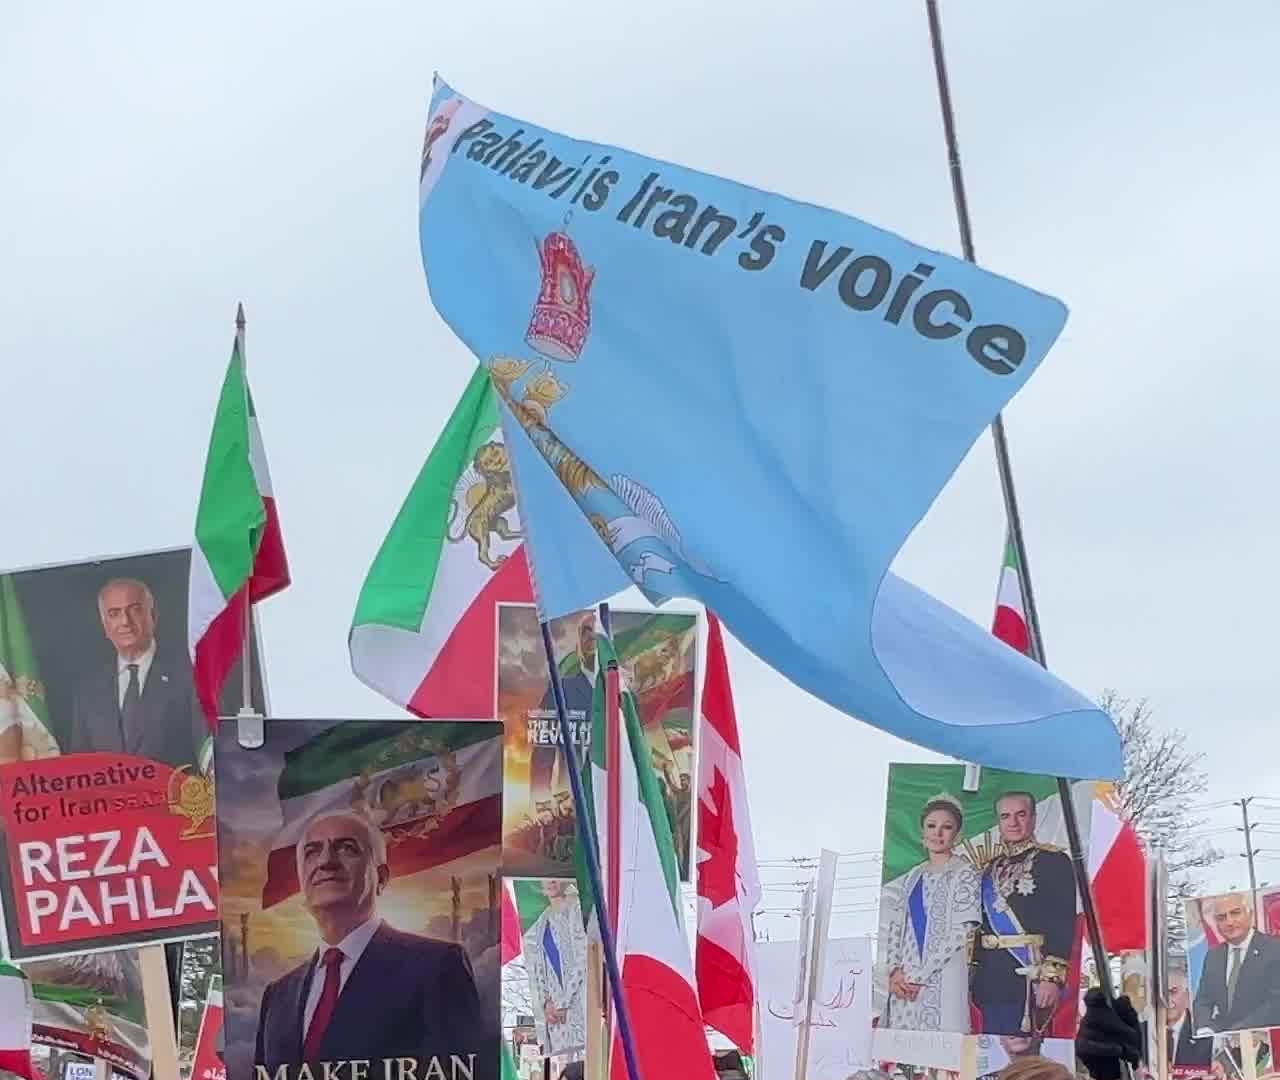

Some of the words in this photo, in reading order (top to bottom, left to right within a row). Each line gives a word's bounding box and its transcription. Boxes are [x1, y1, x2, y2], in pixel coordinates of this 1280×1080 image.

[451, 118, 592, 200] Pahlavi
[570, 154, 620, 212] is
[616, 172, 786, 271] Iran's
[799, 241, 1028, 376] voice
[12, 762, 156, 798] Alternative
[13, 802, 56, 825] for
[60, 797, 109, 818] Iran
[18, 826, 170, 887] REZA
[25, 866, 219, 935] PAHLA
